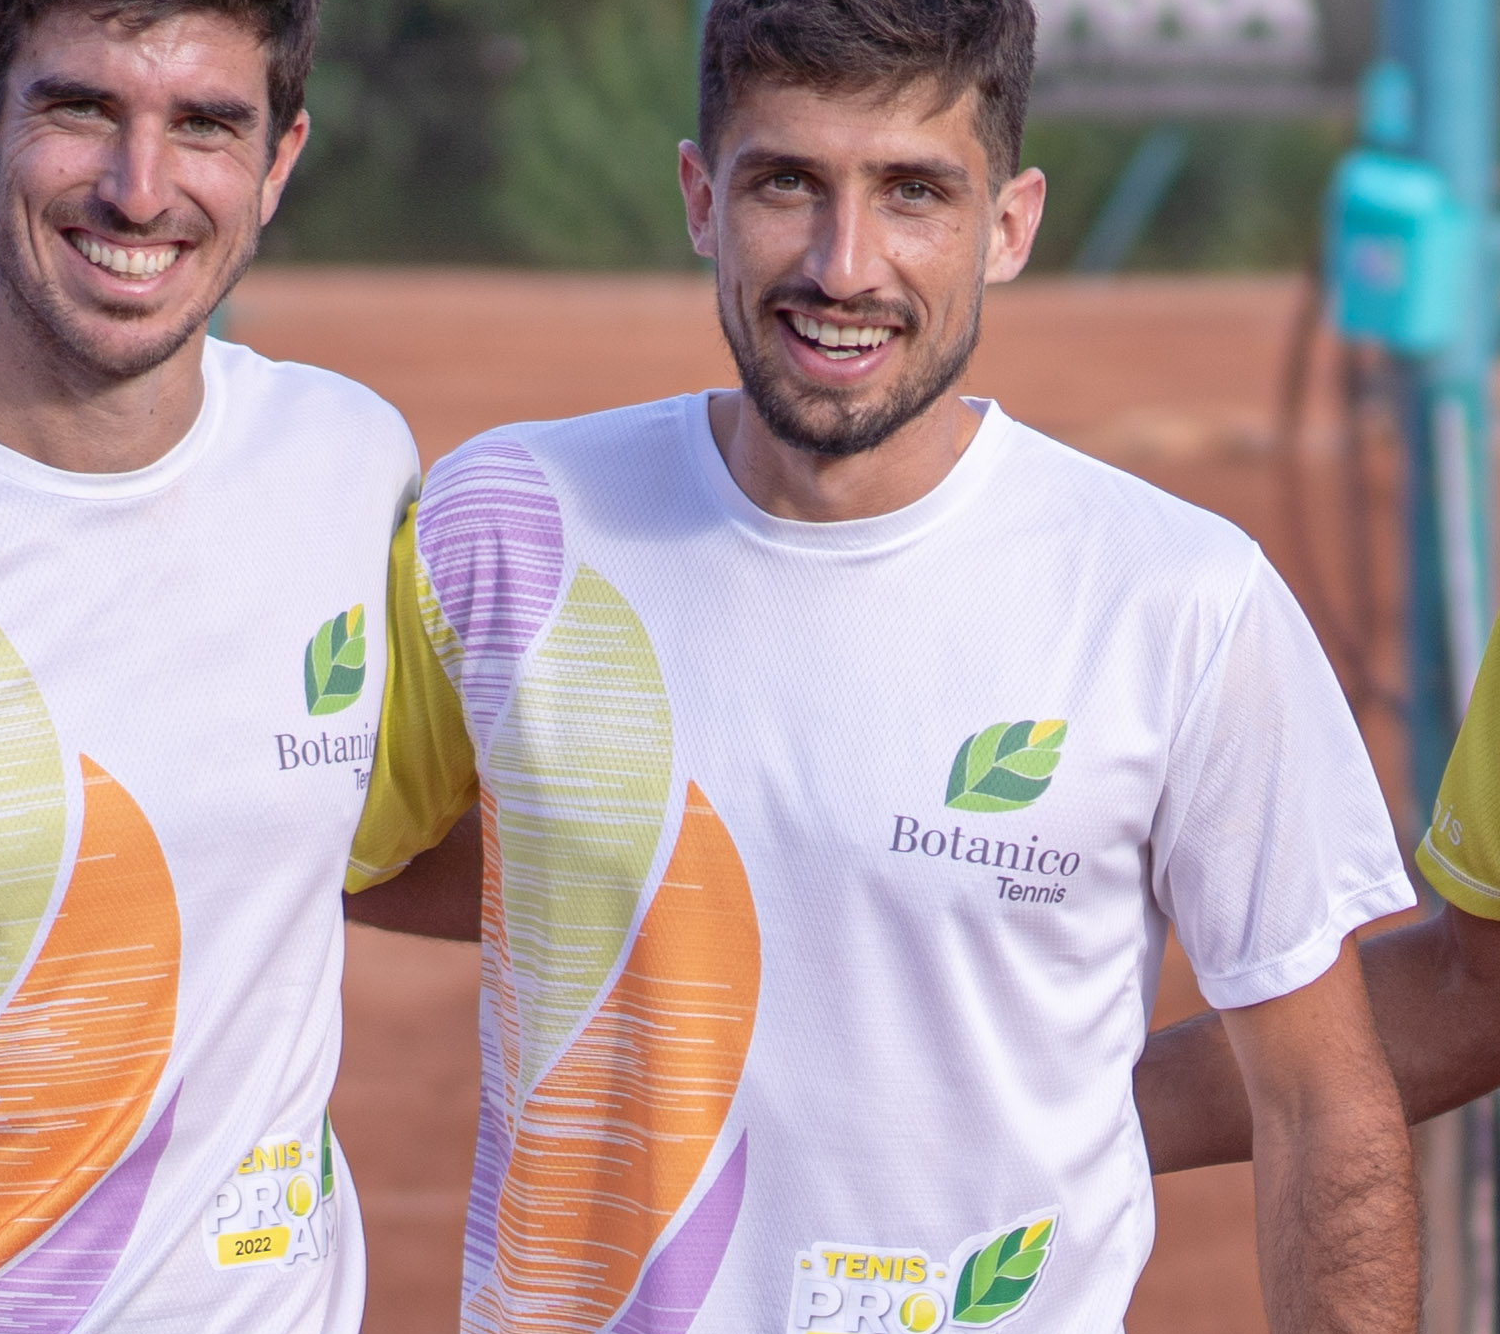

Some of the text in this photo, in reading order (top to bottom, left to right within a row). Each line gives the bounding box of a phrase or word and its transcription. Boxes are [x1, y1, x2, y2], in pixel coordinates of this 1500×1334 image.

[274, 722, 378, 771] Botanic
[888, 814, 1081, 877] Botanico
[996, 876, 1067, 904] Tennis
[236, 1140, 301, 1175] ENIS
[234, 1236, 272, 1256] 2022
[821, 1251, 927, 1283] TENIS
